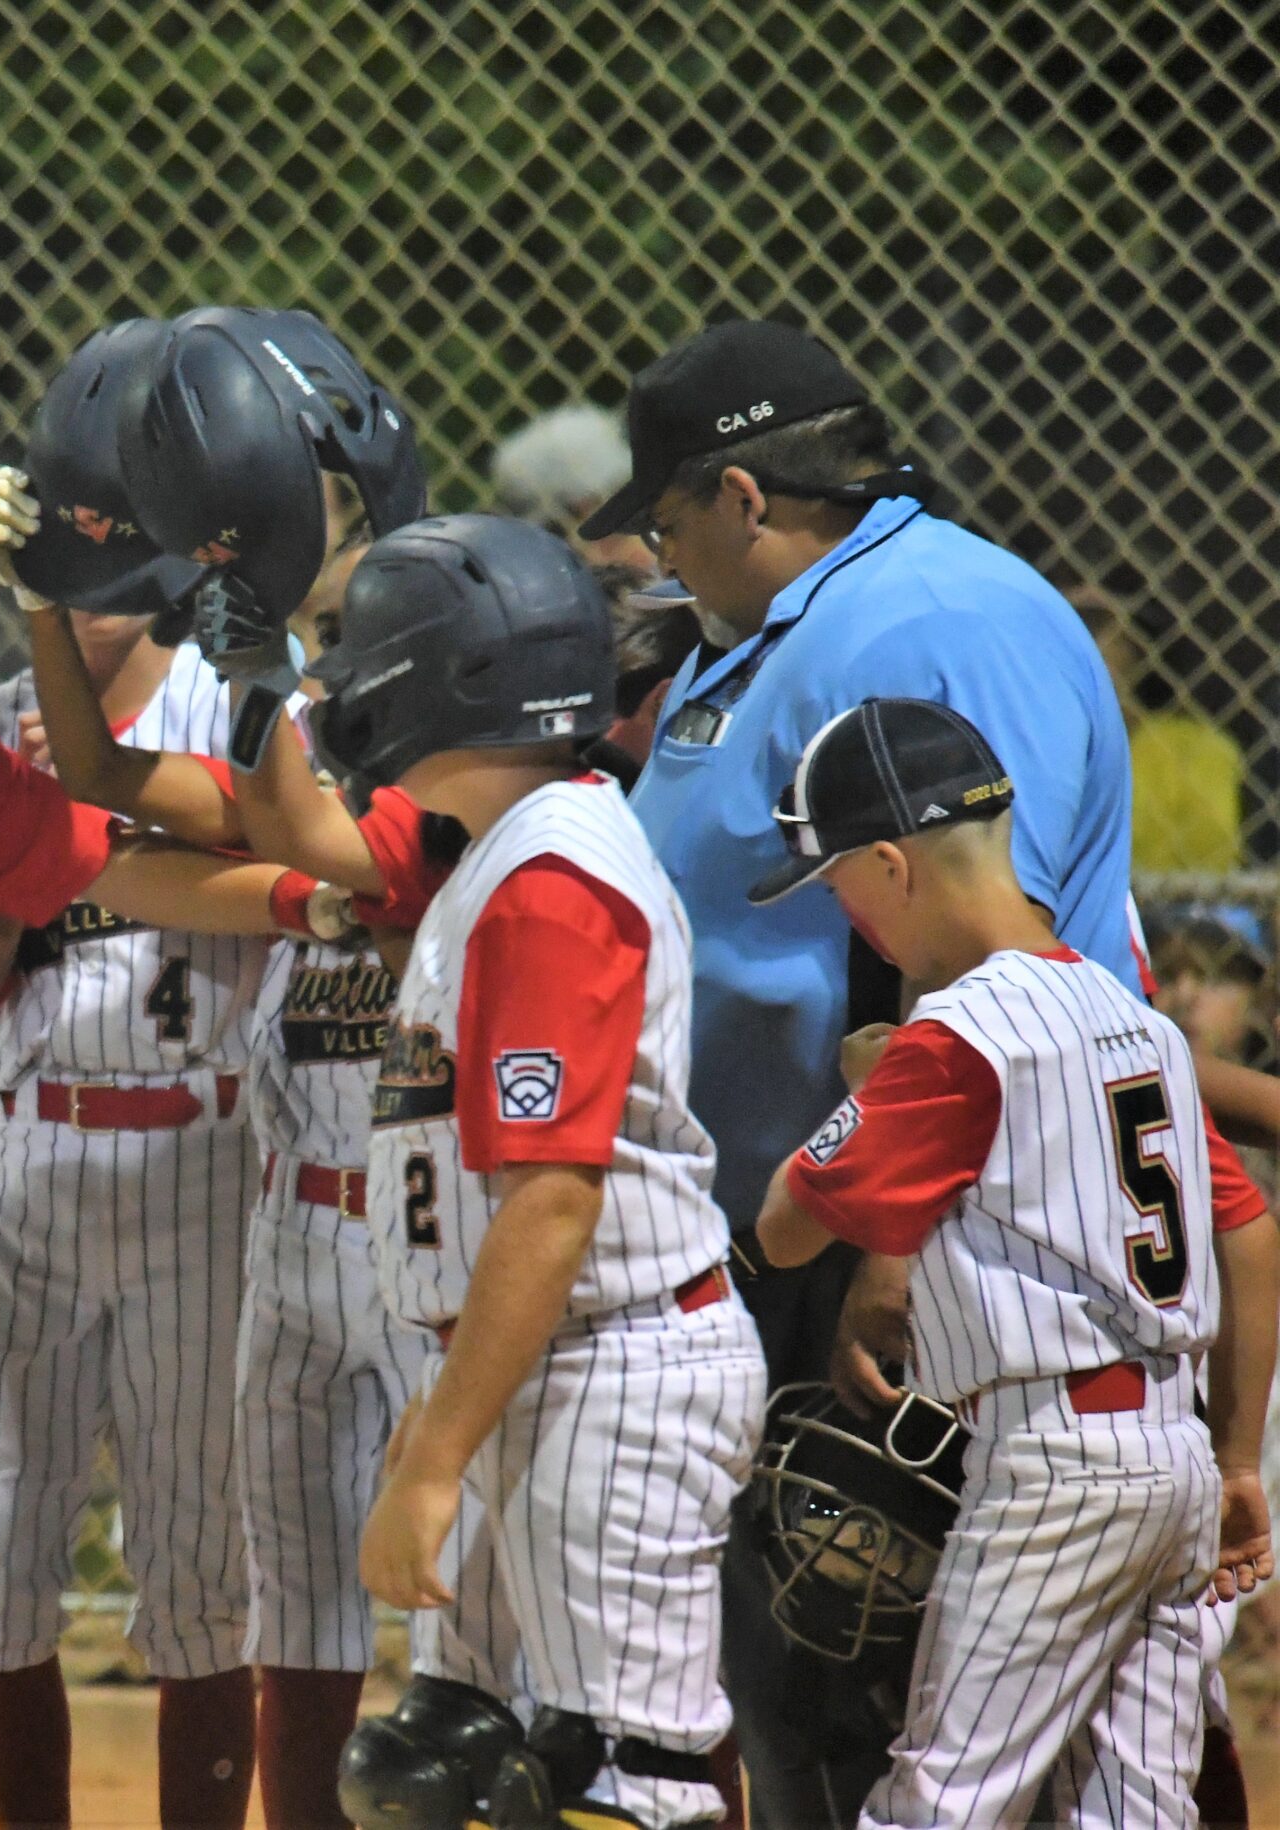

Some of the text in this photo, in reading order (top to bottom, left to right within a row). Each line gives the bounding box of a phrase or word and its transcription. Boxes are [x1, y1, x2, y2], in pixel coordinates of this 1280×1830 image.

[716, 400, 775, 434] CA 66
[143, 954, 197, 1043] 4
[405, 1150, 443, 1250] 2
[1104, 1070, 1192, 1310] 5
